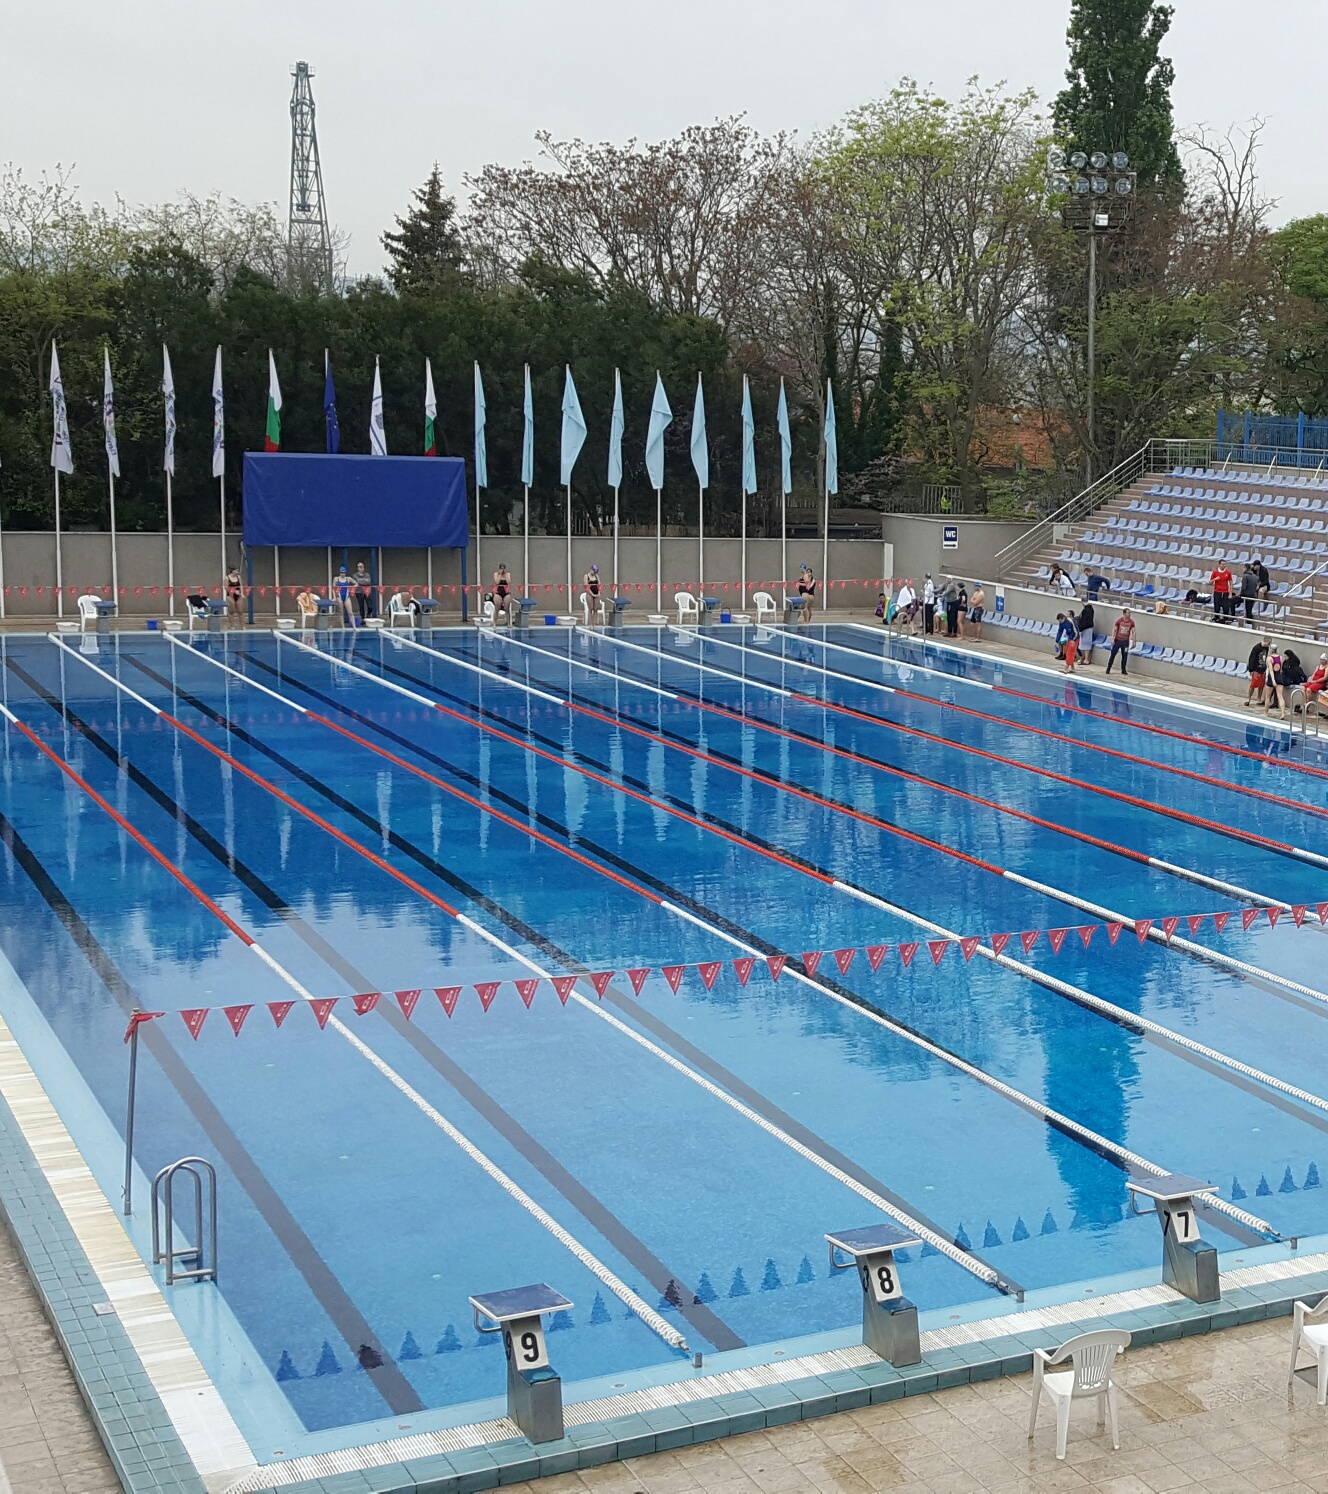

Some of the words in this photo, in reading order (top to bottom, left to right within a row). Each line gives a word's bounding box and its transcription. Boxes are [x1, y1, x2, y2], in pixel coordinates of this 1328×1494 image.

[945, 530, 956, 538] WC
[1163, 1210, 1171, 1237] 7
[1177, 1211, 1190, 1238] 7
[877, 1266, 894, 1294] 8
[520, 1331, 540, 1363] 9
